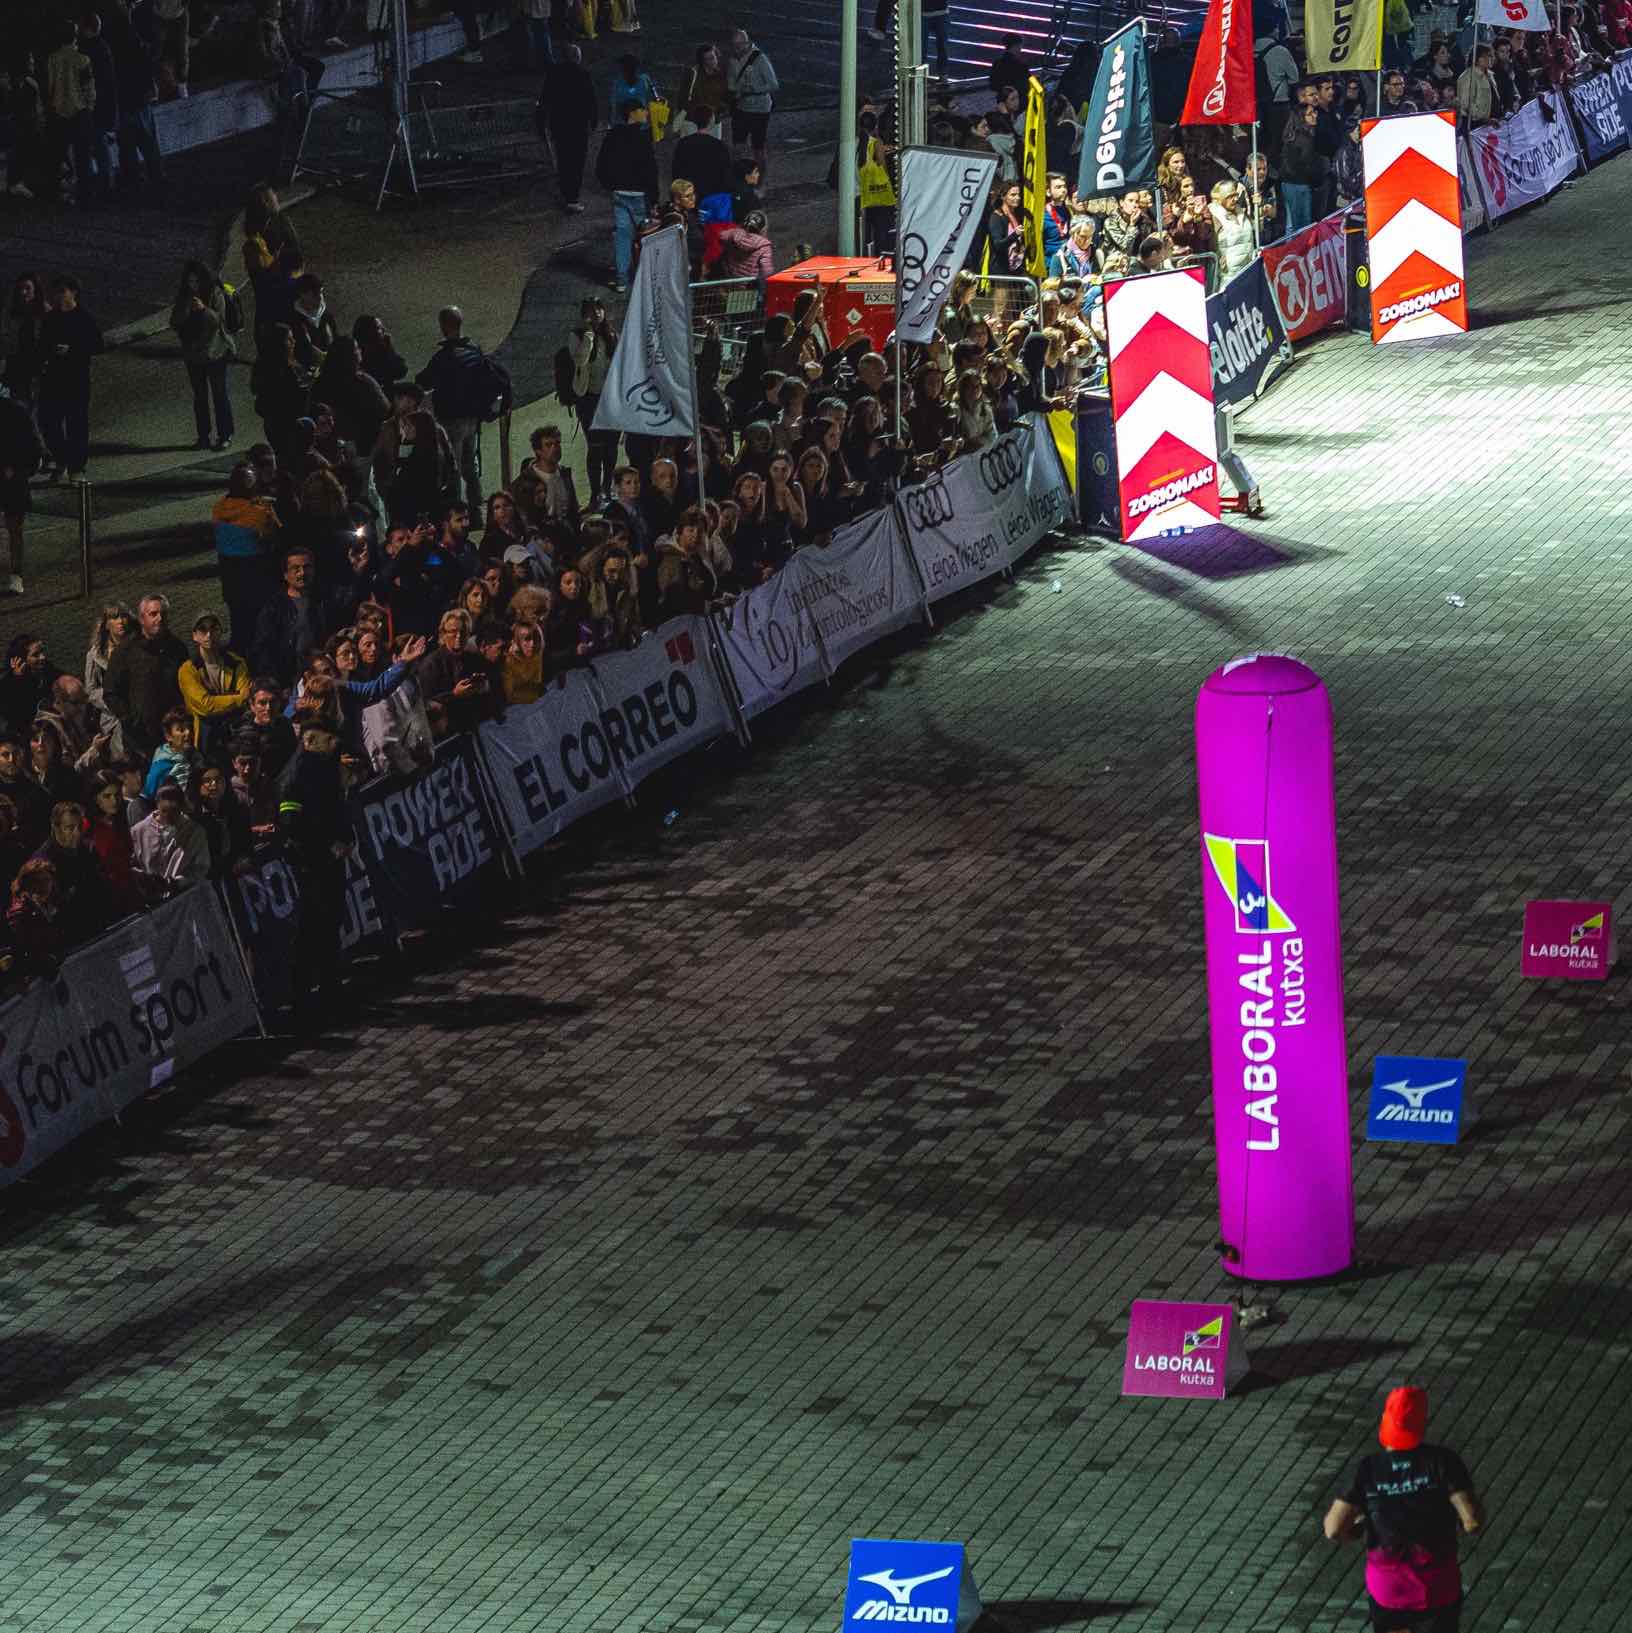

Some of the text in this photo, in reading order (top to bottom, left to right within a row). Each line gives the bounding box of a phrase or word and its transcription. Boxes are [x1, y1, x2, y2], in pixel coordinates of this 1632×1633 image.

[1379, 281, 1461, 325] ZORIONAK!
[1127, 465, 1215, 518] ZORIONAK!
[519, 670, 697, 825] EL CORREO
[364, 770, 475, 869] POWER
[432, 826, 494, 891] ADE
[1530, 944, 1599, 959] LABORAL
[1281, 937, 1304, 1028] kutxa
[1238, 939, 1279, 1152] LABORAL
[1134, 1354, 1215, 1374] LABORAL
[1180, 1372, 1215, 1386] kutxa
